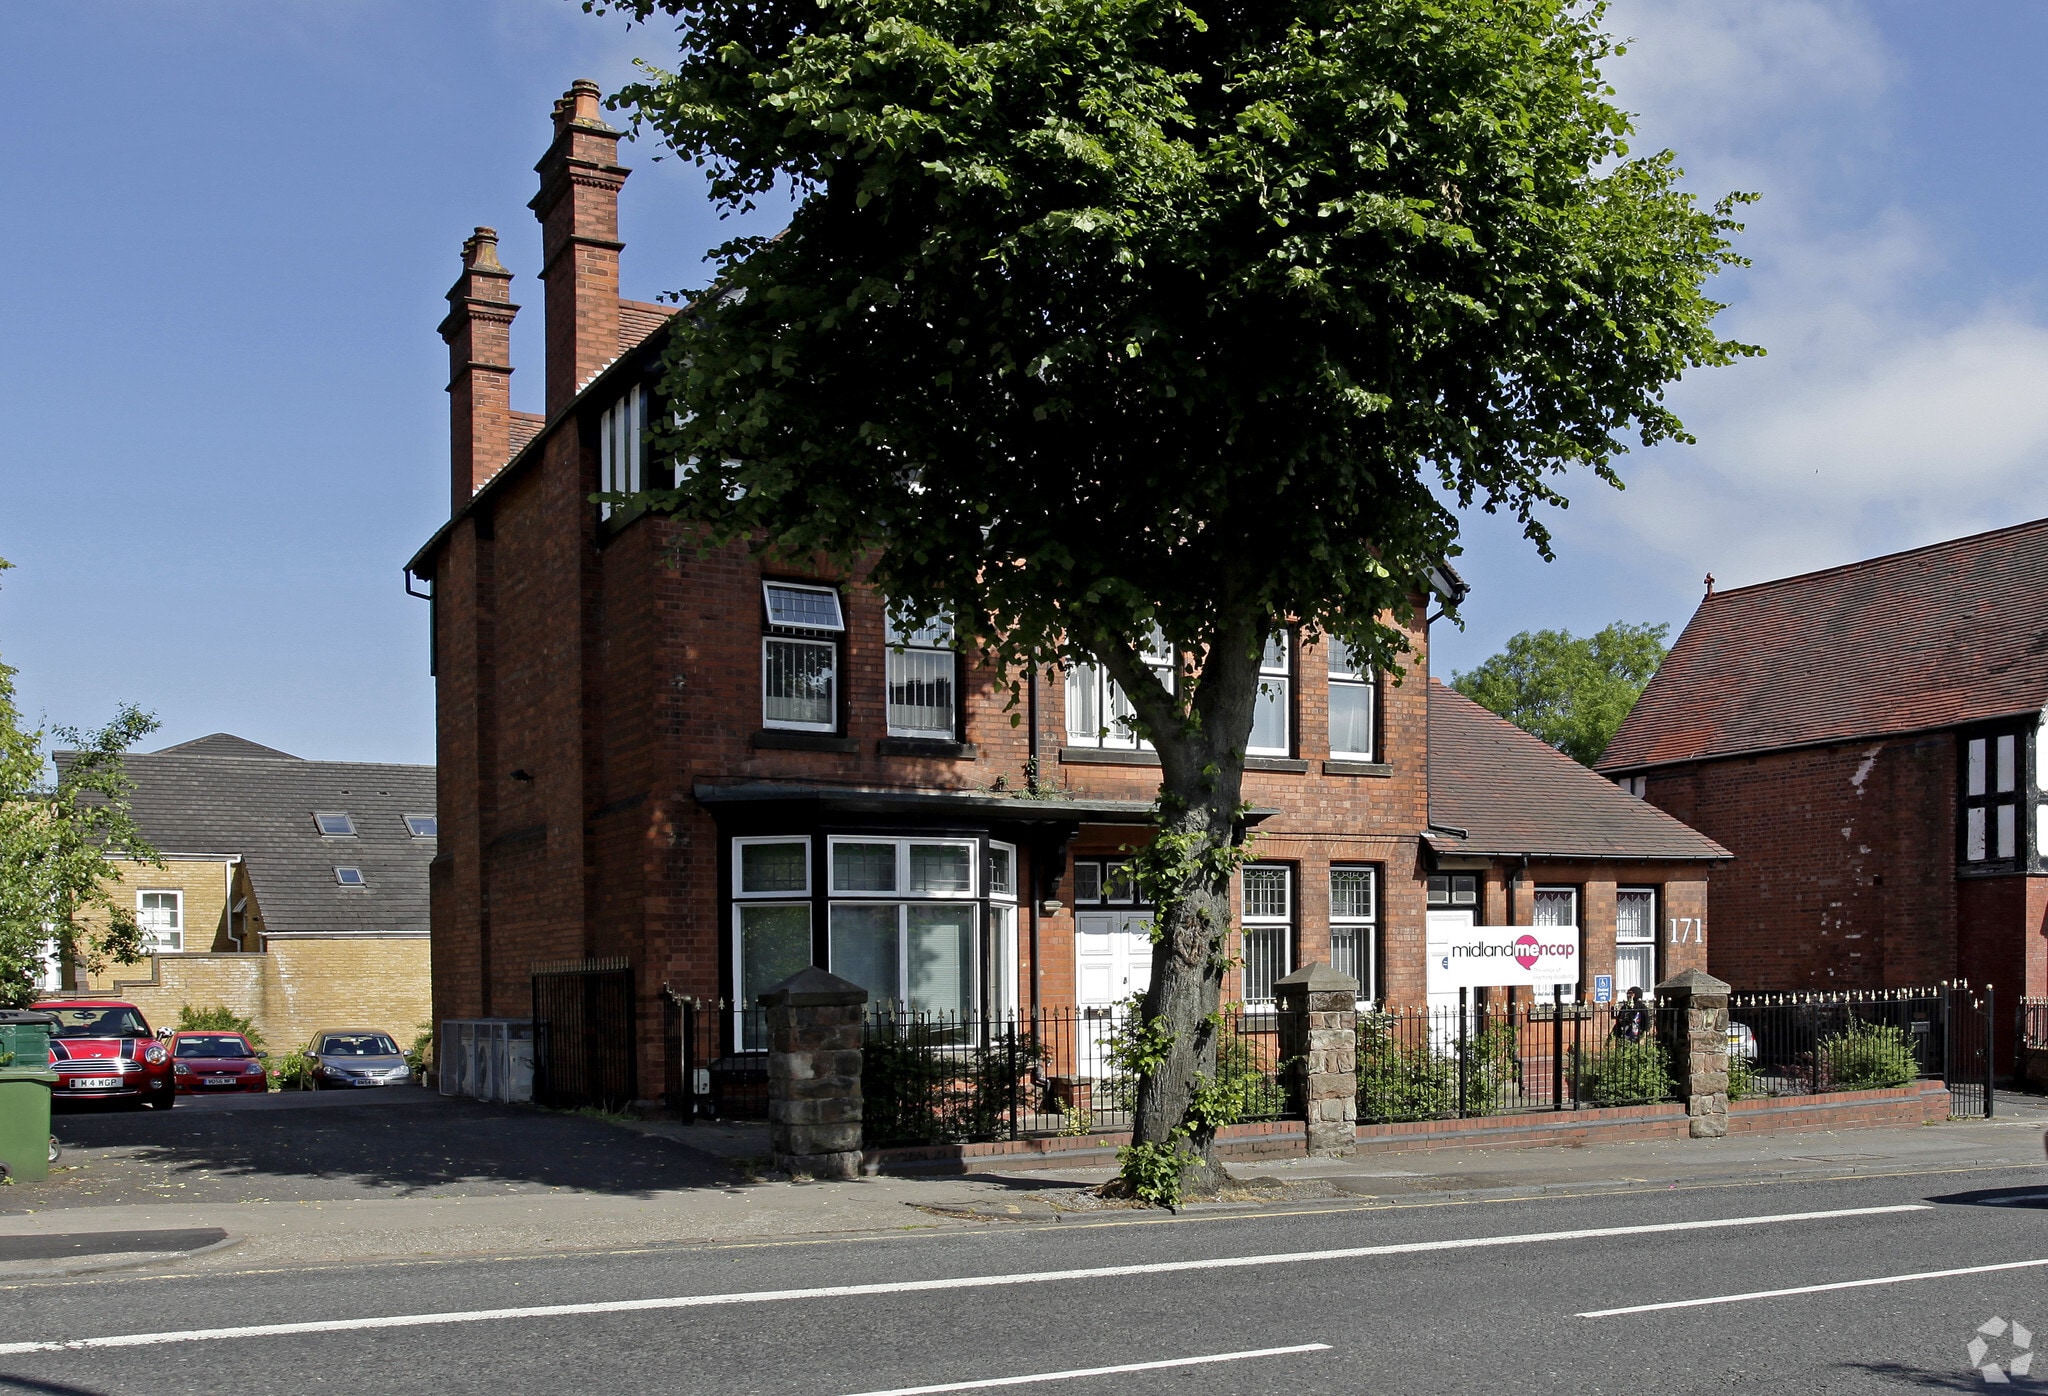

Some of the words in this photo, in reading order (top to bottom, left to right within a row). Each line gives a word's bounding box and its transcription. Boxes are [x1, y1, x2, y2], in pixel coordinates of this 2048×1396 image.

[1669, 918, 1703, 944] 171
[1452, 940, 1513, 958] midland
[1515, 943, 1575, 960] mencap
